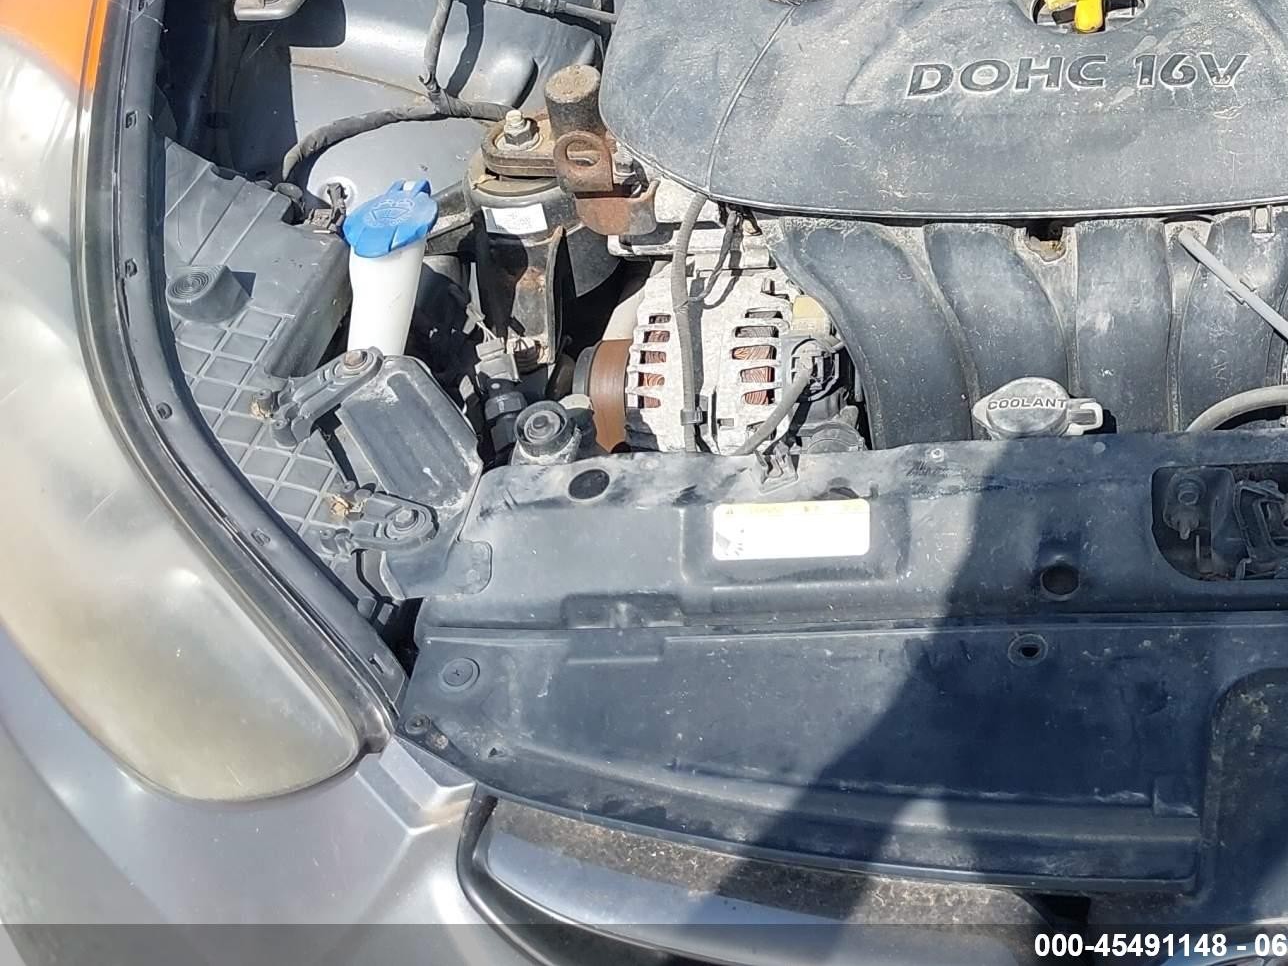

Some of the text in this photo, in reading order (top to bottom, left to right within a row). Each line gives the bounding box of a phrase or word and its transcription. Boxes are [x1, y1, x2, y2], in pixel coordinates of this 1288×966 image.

[905, 52, 1250, 98] DOHC 16V
[987, 397, 1067, 411] COOLANT
